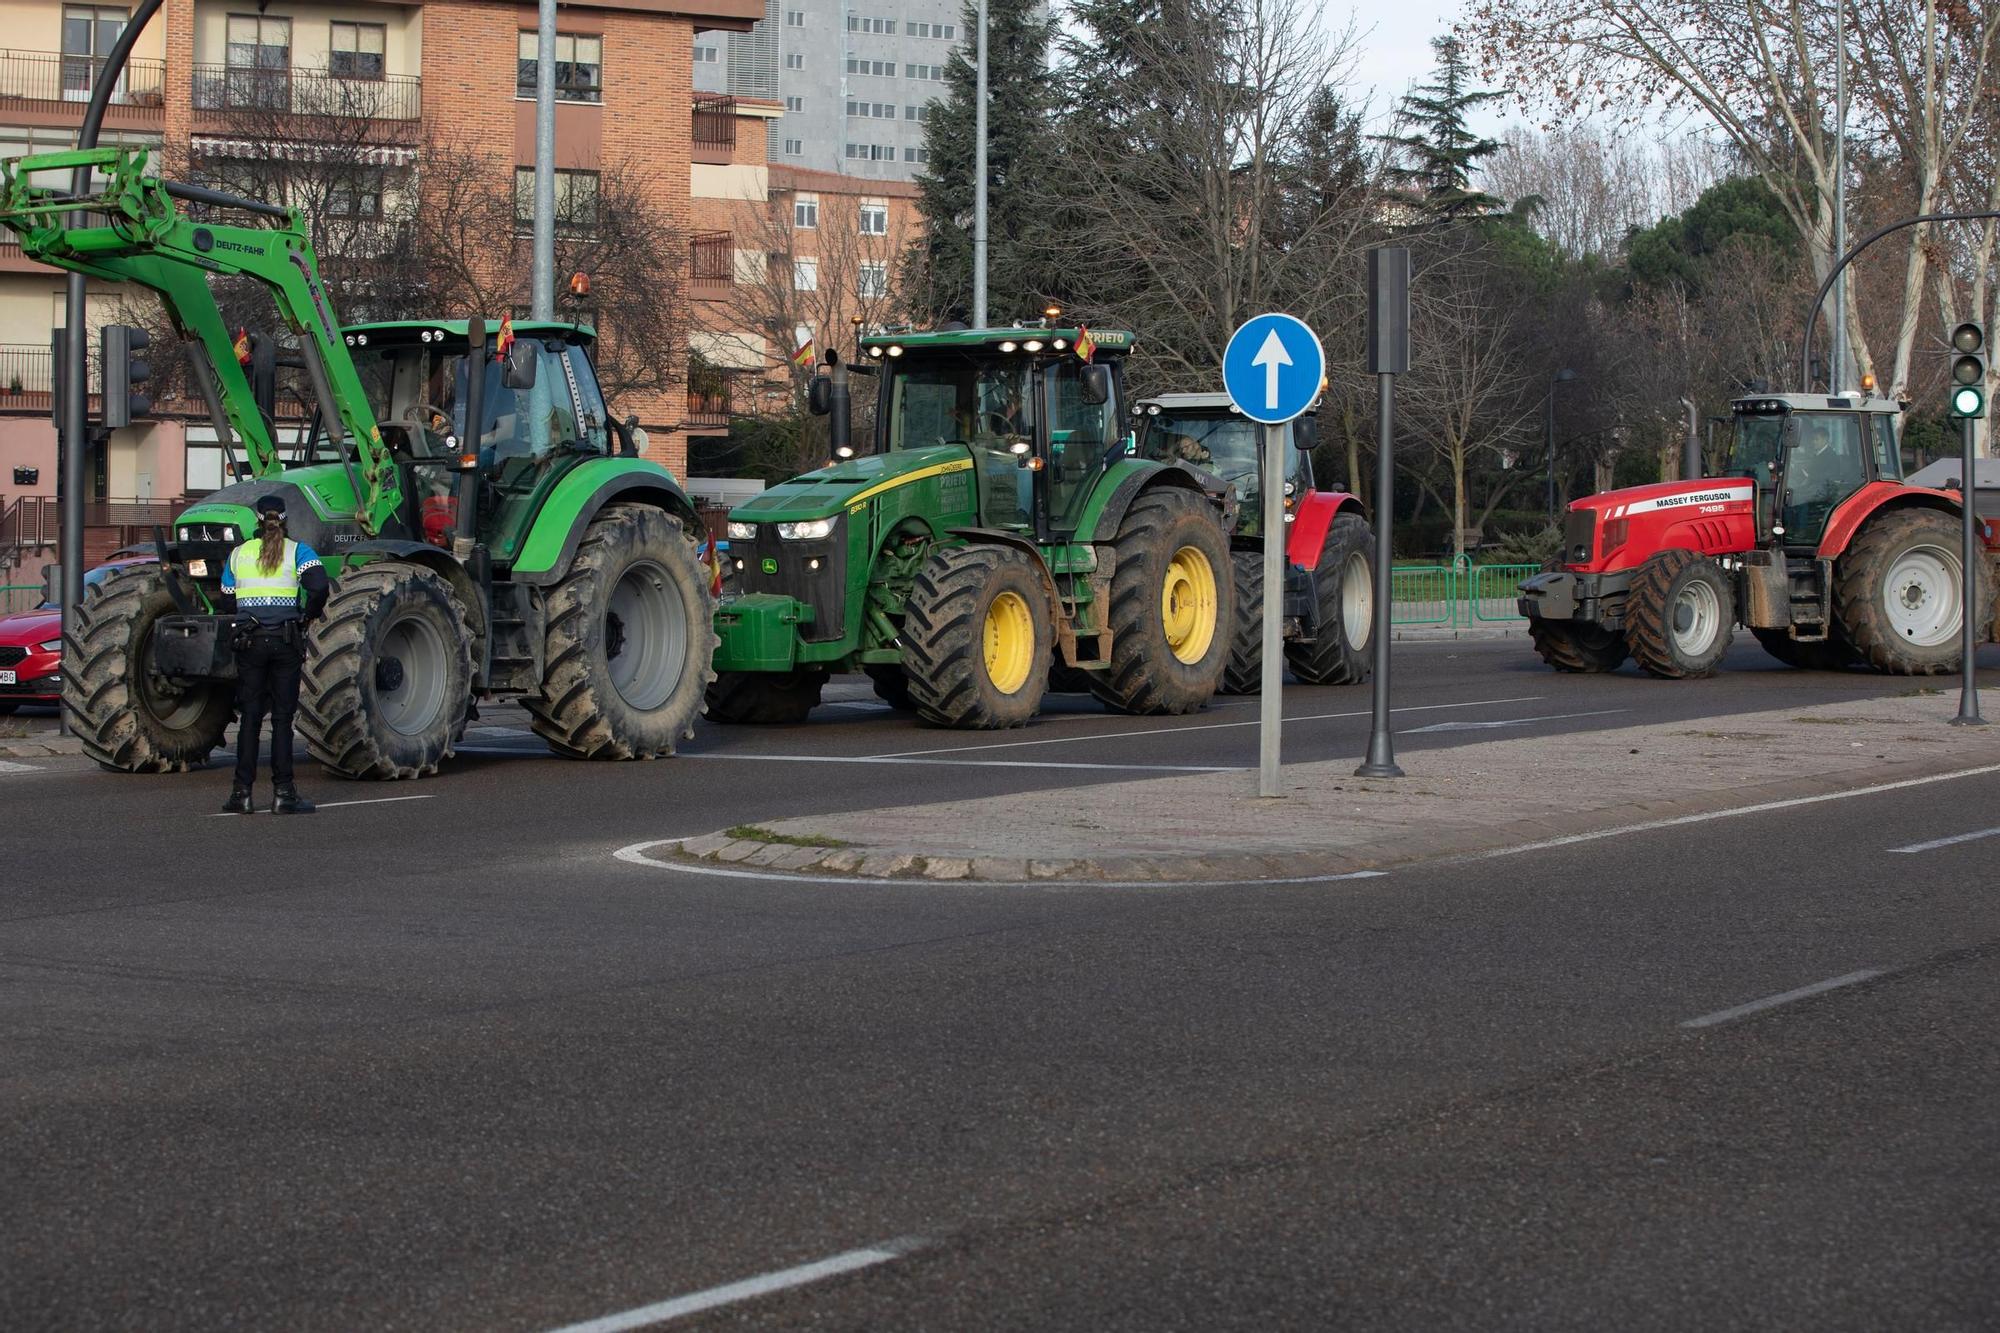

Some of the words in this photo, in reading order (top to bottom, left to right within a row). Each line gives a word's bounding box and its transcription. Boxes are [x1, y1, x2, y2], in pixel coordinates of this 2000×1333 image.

[216, 240, 265, 256] DEUTZ-FAHR
[1087, 332, 1125, 344] PRIETO
[940, 473, 967, 488] PRIETO
[1656, 496, 1688, 508] MASSEY
[1690, 492, 1731, 503] FERGUSON
